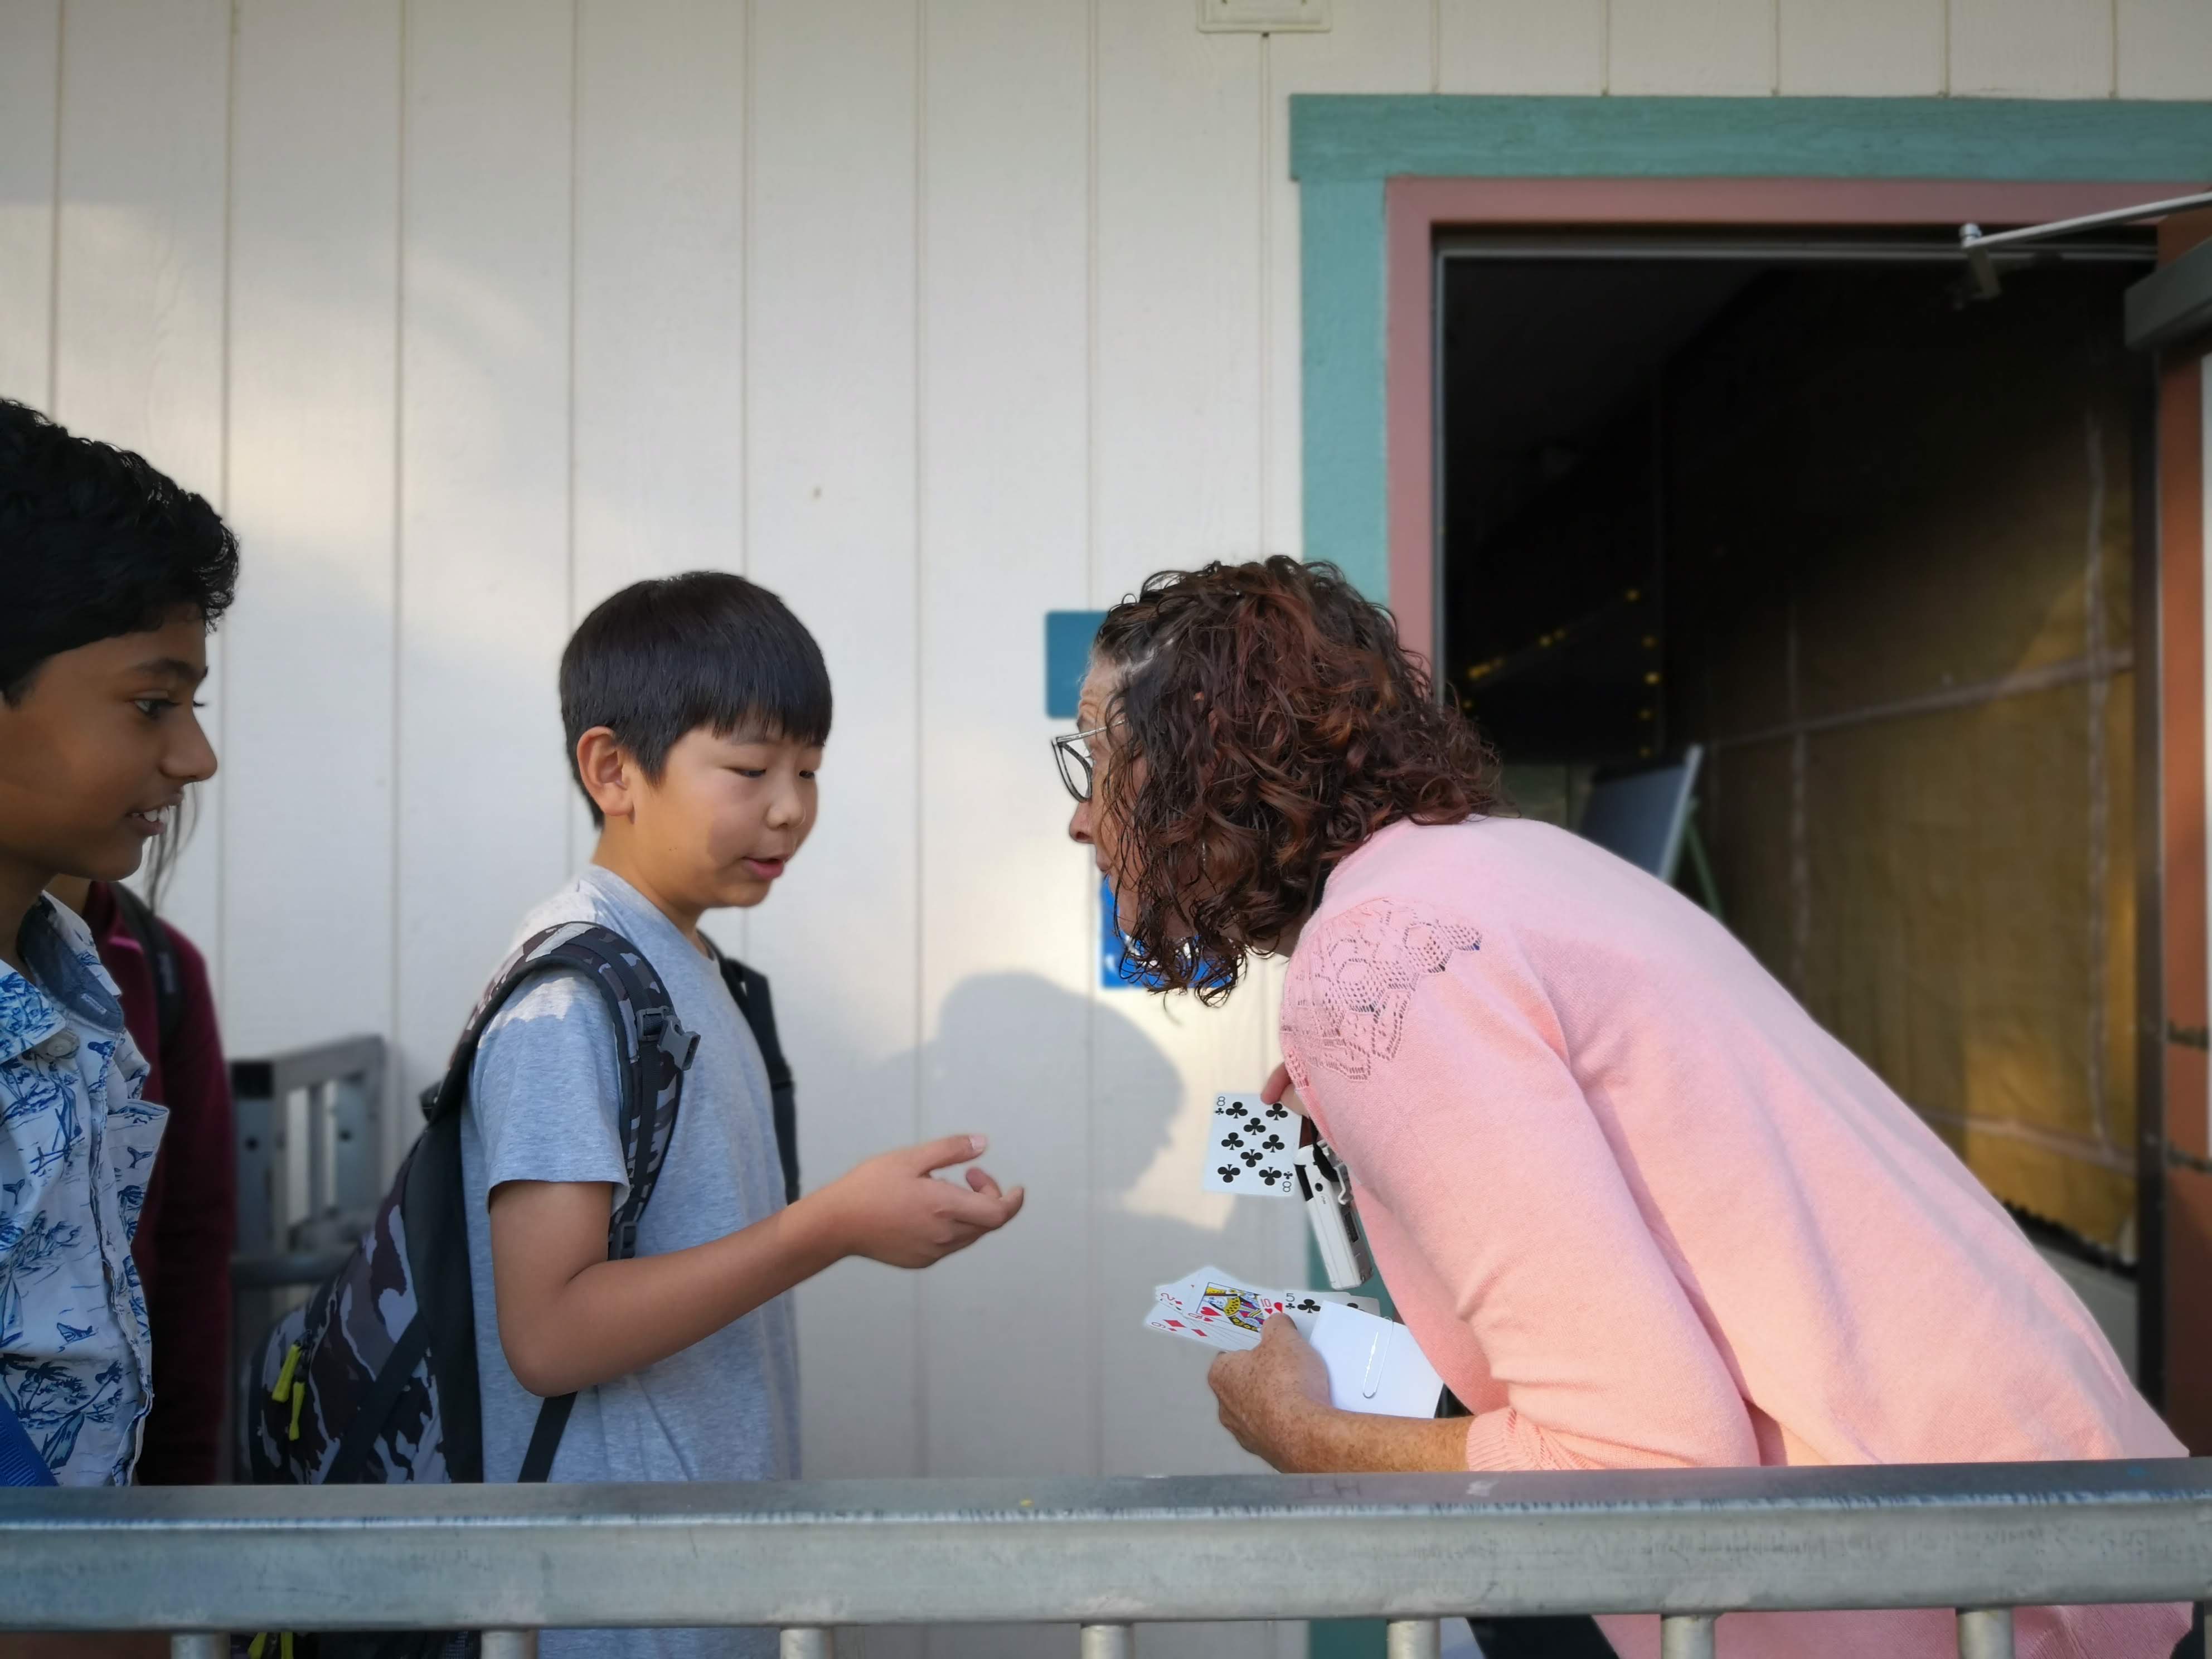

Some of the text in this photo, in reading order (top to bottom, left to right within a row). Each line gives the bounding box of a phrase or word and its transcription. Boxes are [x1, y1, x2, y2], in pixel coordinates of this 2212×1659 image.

[1217, 1096, 1225, 1106] 8
[1282, 1181, 1292, 1192] 8
[1286, 1293, 1295, 1302] 5
[1260, 1298, 1271, 1307] 10
